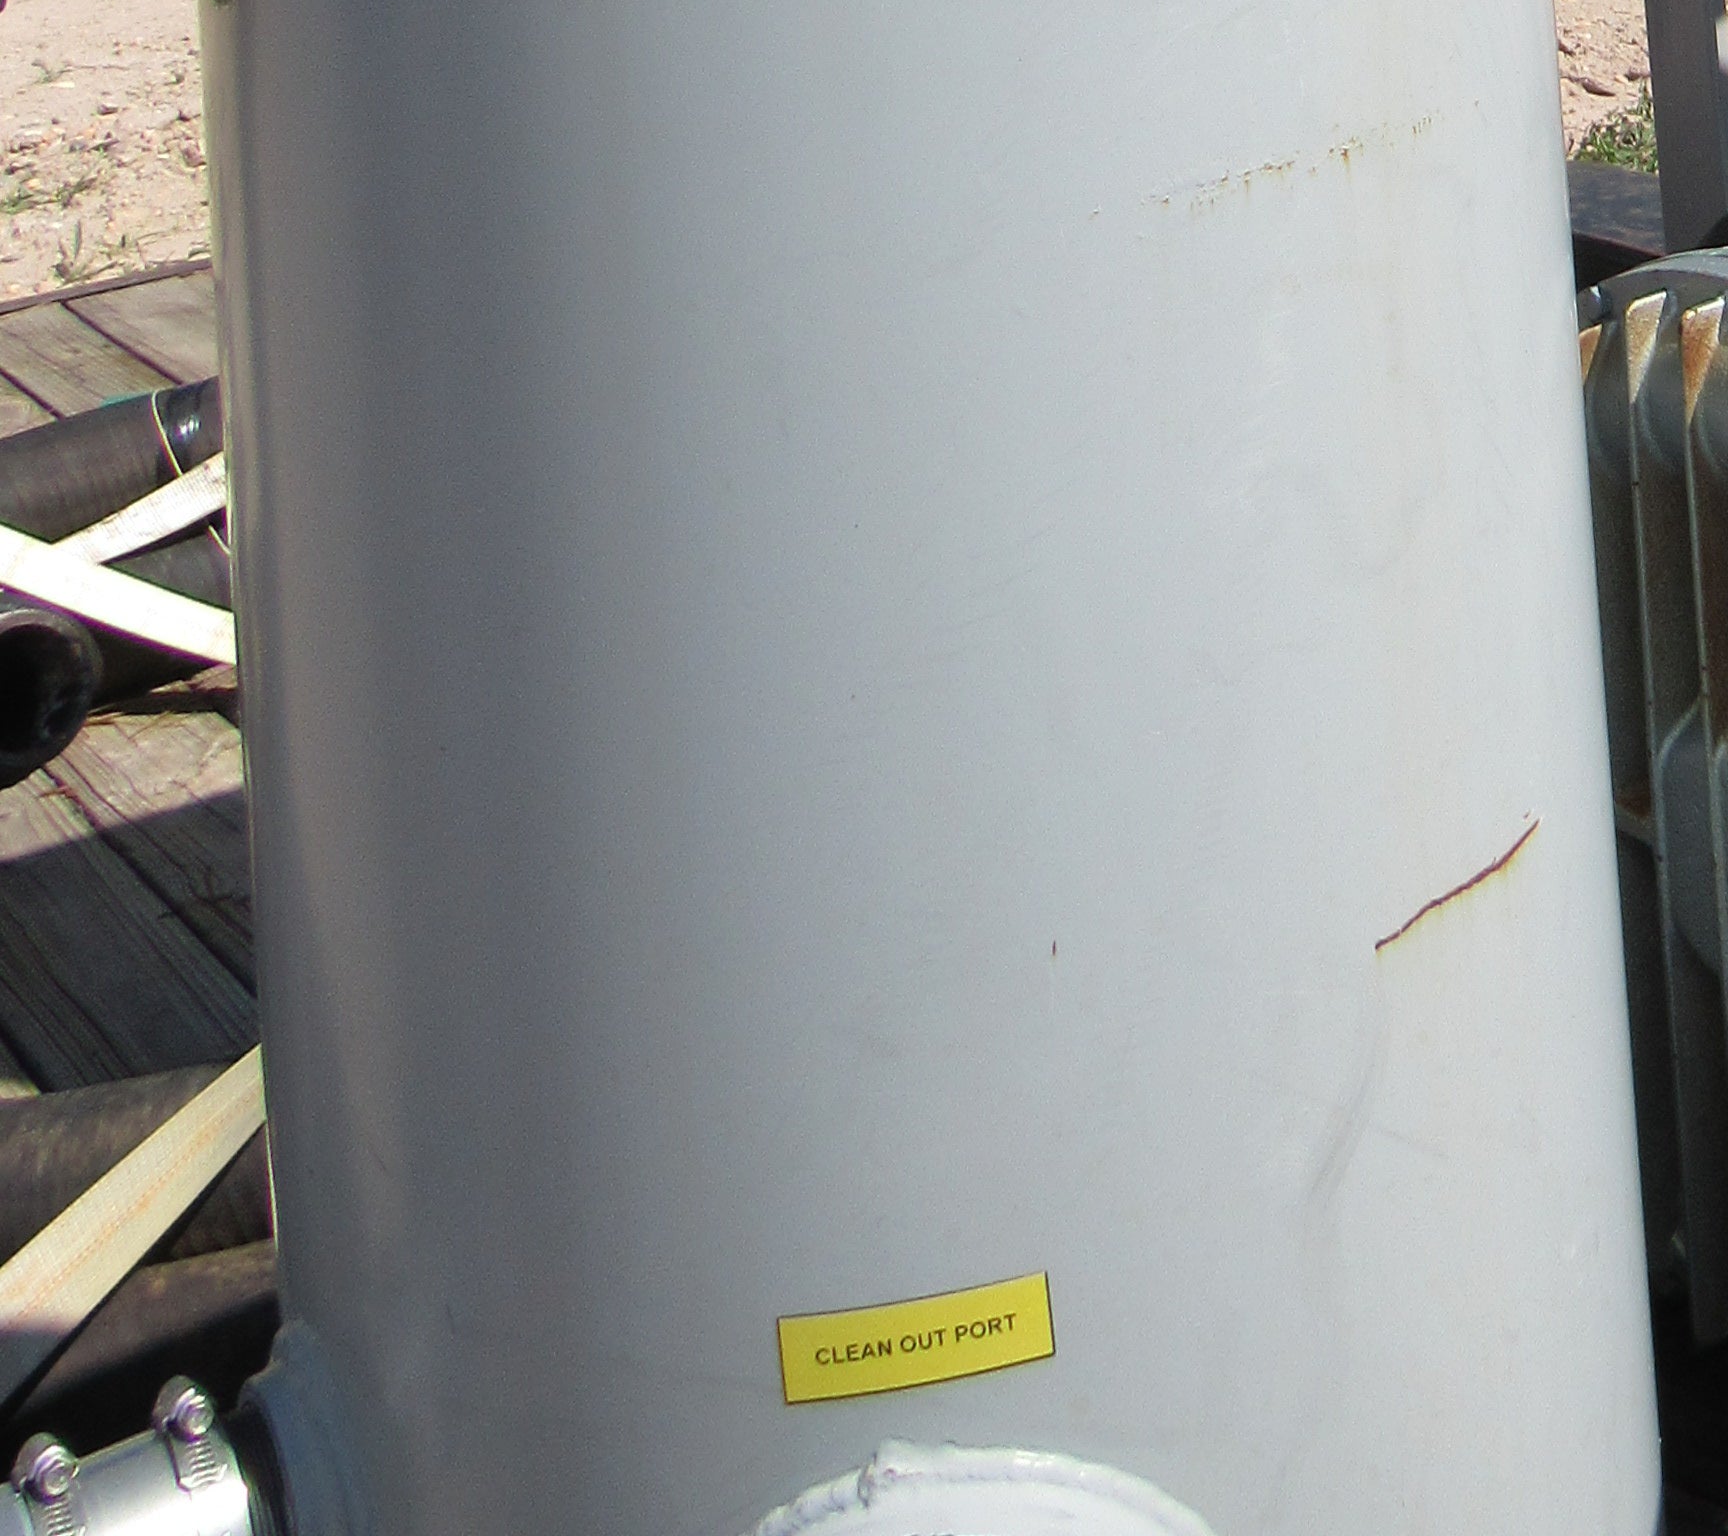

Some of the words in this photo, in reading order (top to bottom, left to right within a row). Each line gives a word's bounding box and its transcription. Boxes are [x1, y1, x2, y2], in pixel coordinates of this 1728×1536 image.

[815, 1339, 892, 1365] CLEAN
[900, 1329, 947, 1353] OUT
[955, 1313, 1017, 1342] PORT
